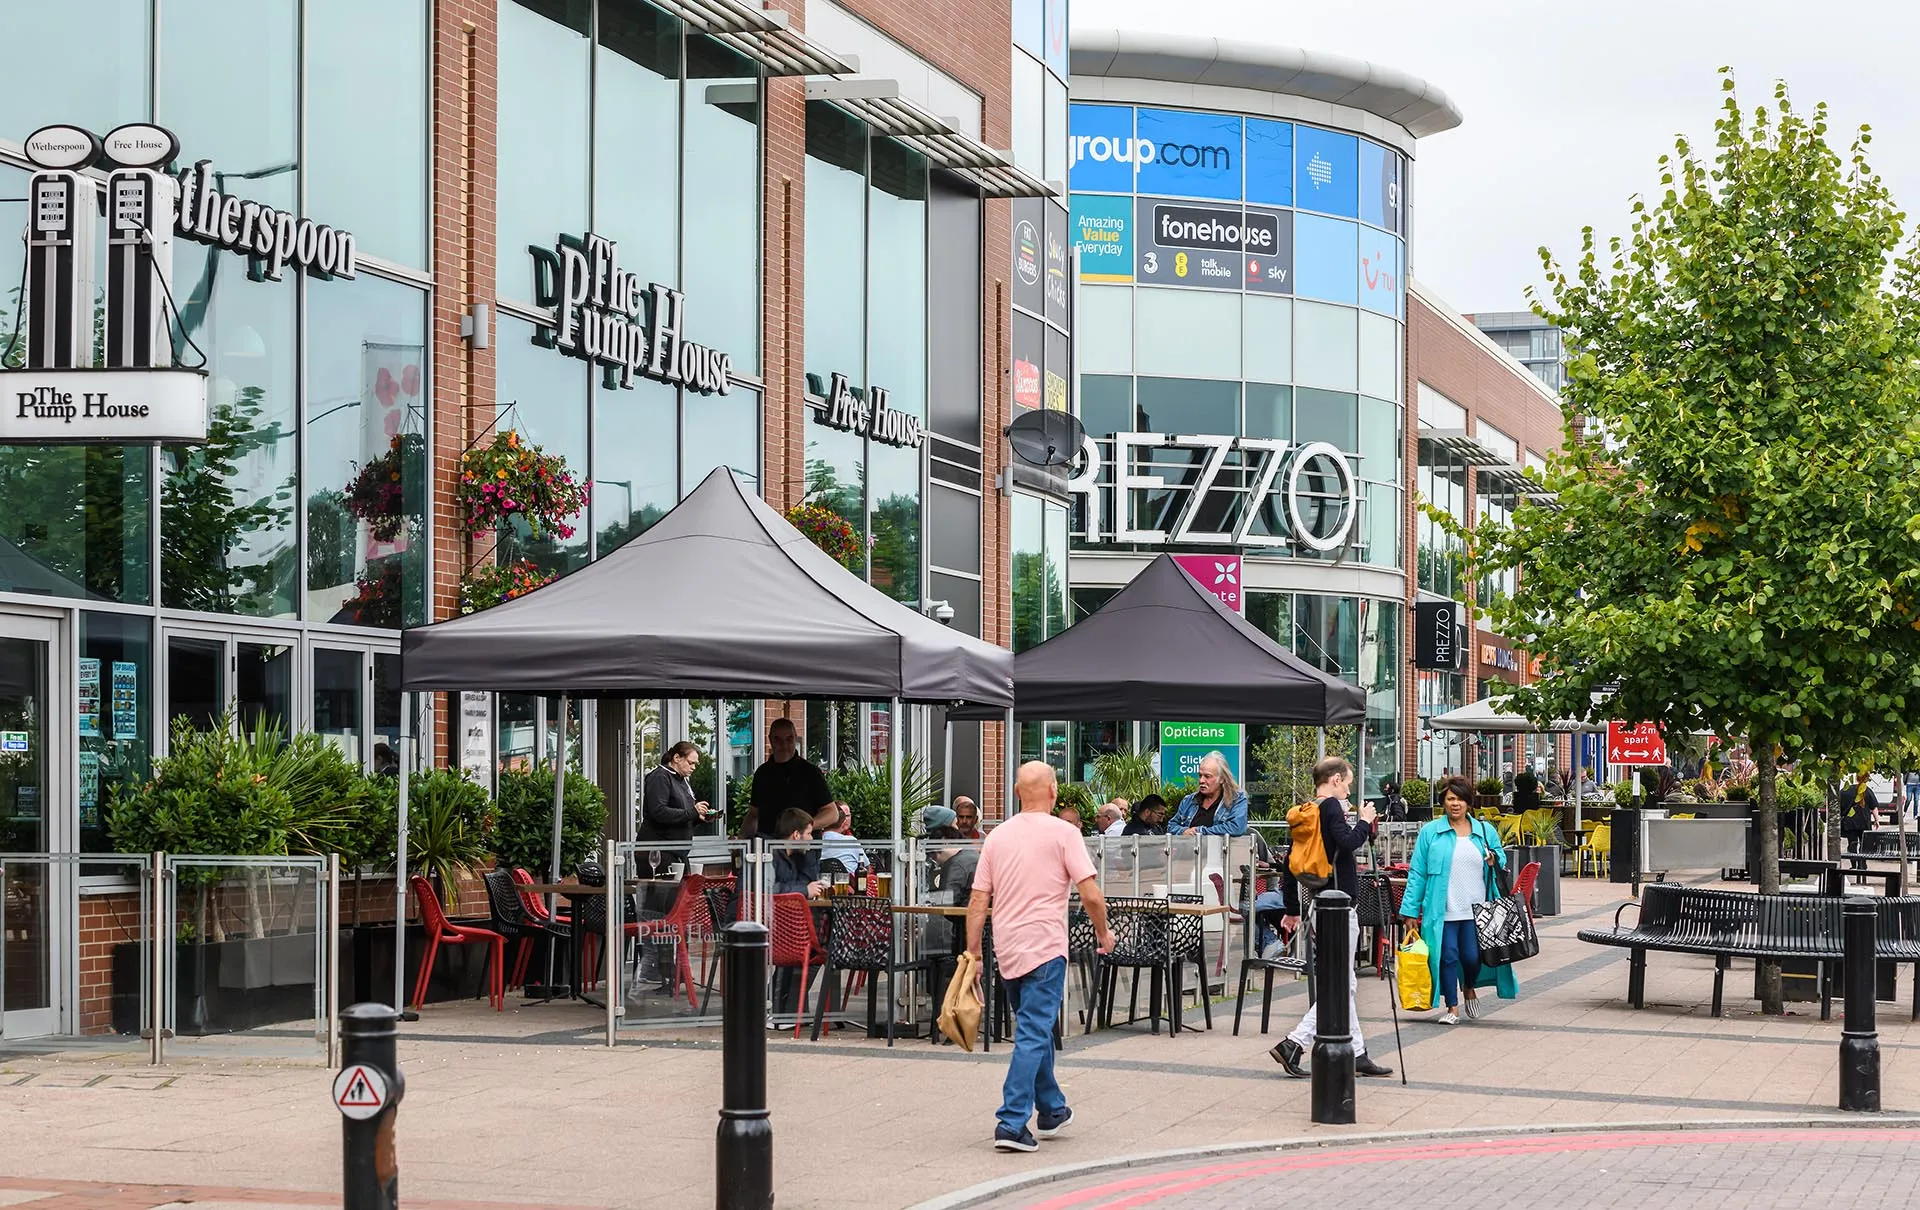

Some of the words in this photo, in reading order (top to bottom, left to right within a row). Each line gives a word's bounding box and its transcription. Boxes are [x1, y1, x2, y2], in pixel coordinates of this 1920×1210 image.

[31, 142, 85, 152] Wetherspoon
[114, 140, 132, 149] Free
[136, 140, 163, 149] House
[172, 160, 356, 281] therspoon
[1078, 215, 1124, 231] Amazing
[1082, 228, 1120, 242] Value
[1161, 214, 1272, 246] fonehouse
[1075, 240, 1123, 257] Everyday
[1143, 252, 1159, 274] 3
[1201, 258, 1218, 269] talk
[584, 232, 641, 318] The
[1201, 267, 1232, 278] mobile
[1268, 265, 1287, 283] sky
[555, 243, 645, 390] Pump
[648, 282, 734, 396] House
[34, 387, 73, 405] The
[16, 392, 77, 424] Pump
[82, 393, 149, 418] House
[829, 371, 868, 434] Free
[870, 385, 923, 449] House
[1068, 431, 1357, 551] REZZO
[1436, 608, 1450, 663] PREZZO
[1164, 725, 1225, 739] Opticians
[1623, 736, 1649, 744] apart
[1179, 765, 1201, 774] Coll
[636, 924, 682, 946] Pump
[652, 919, 679, 934] The
